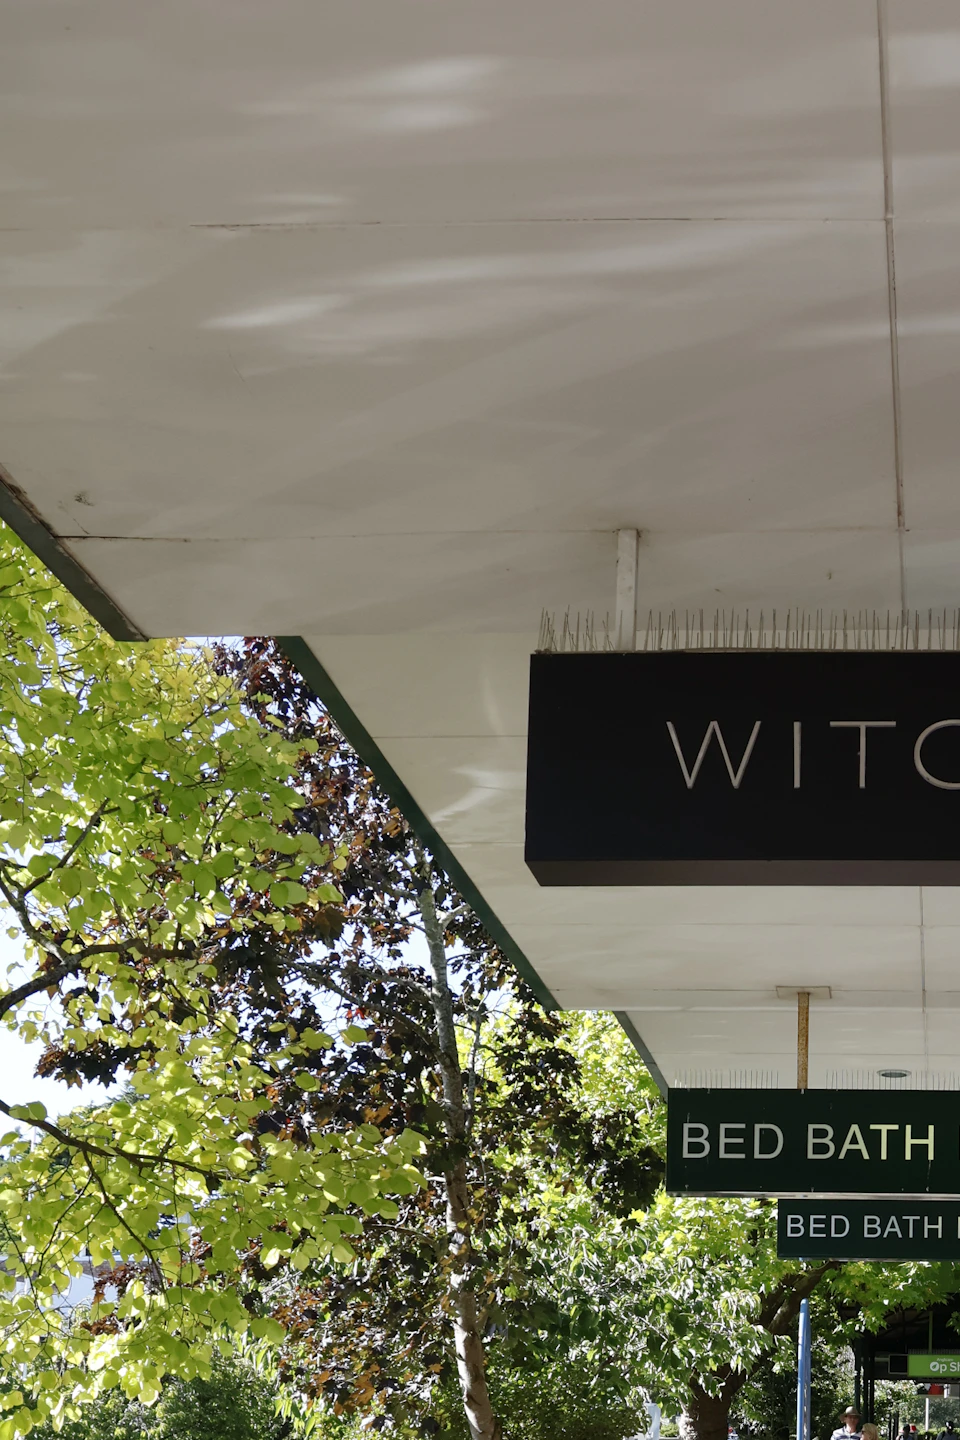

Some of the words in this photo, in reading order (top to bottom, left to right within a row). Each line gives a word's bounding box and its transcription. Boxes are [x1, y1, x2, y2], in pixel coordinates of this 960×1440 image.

[682, 1122, 784, 1160] BED
[806, 1123, 935, 1161] BATH
[786, 1214, 850, 1238] BED
[863, 1215, 943, 1239] BATH
[929, 1361, 947, 1374] Op
